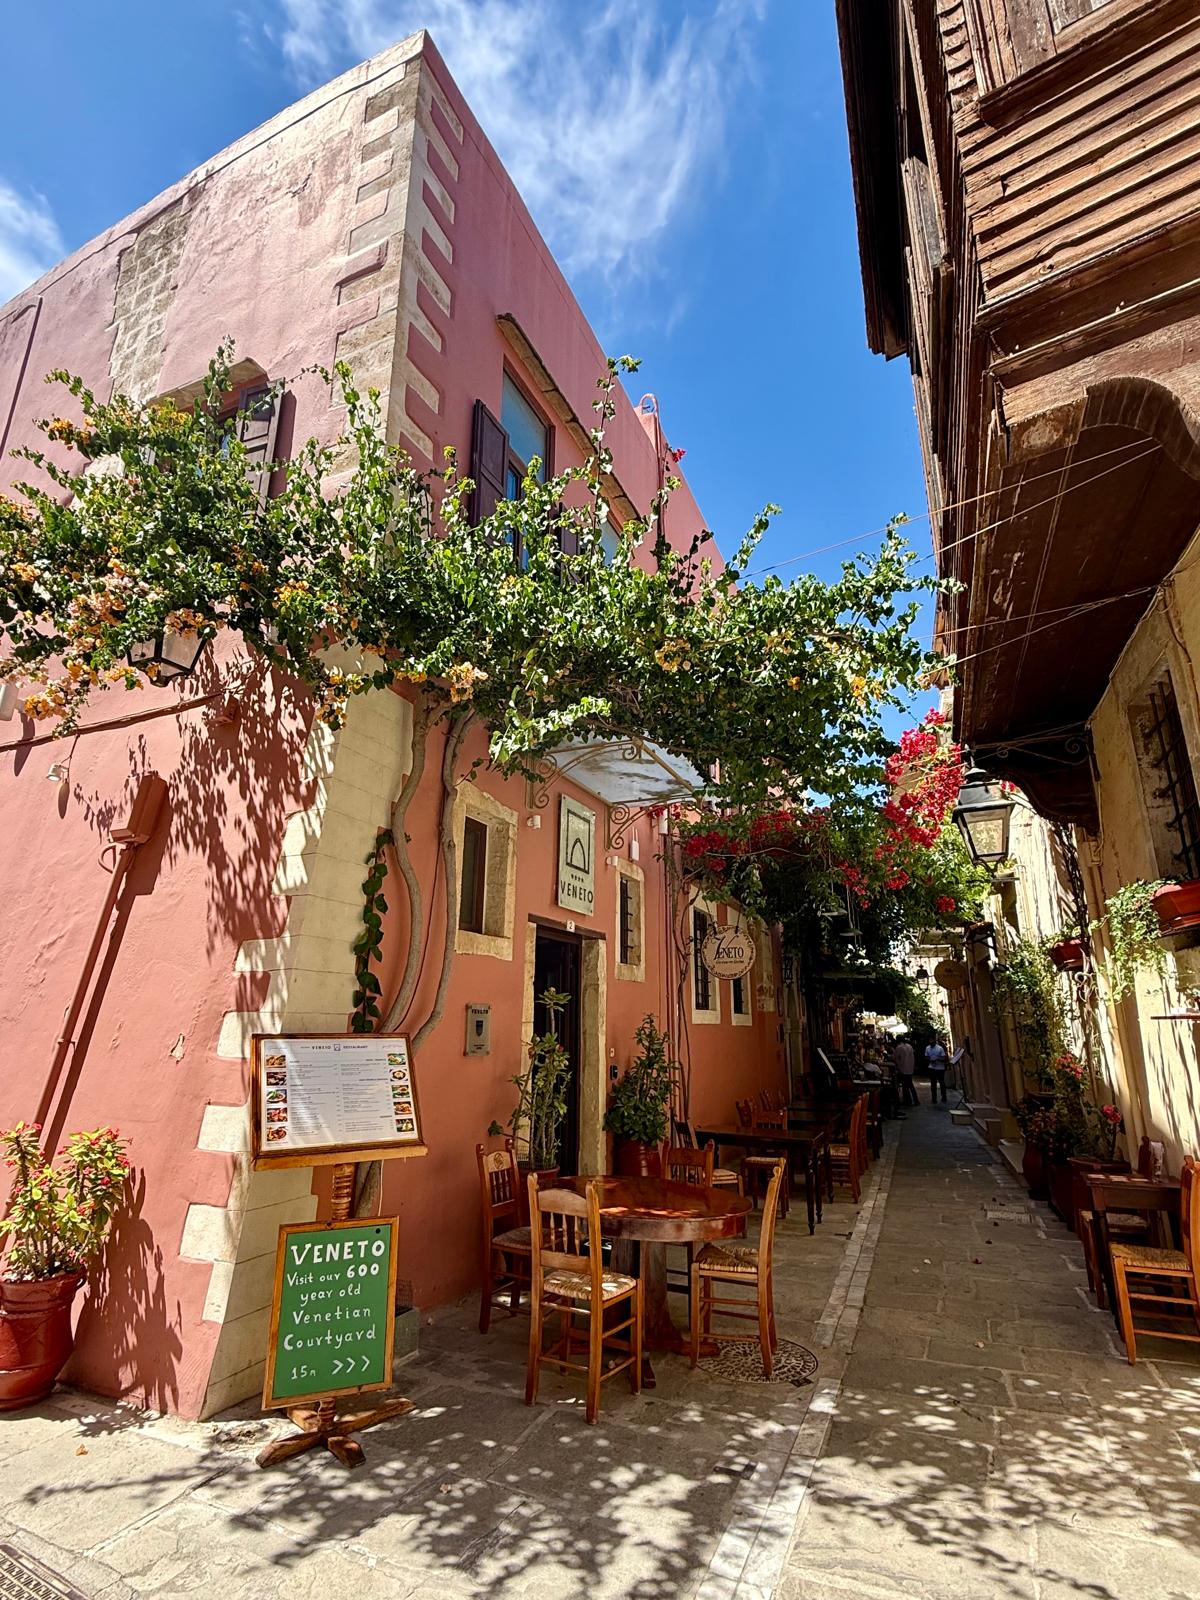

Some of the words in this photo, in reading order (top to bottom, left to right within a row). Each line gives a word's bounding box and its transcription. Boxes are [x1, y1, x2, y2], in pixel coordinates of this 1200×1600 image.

[560, 880, 593, 903] VENETO
[568, 921, 573, 930] 2
[290, 1239, 385, 1265] VENETO
[287, 1271, 314, 1287] Visit
[319, 1273, 341, 1282] our
[346, 1262, 380, 1279] 600
[300, 1289, 333, 1307] year
[339, 1283, 361, 1297] old
[292, 1306, 371, 1325] Venetian
[283, 1324, 377, 1351] Courtyard
